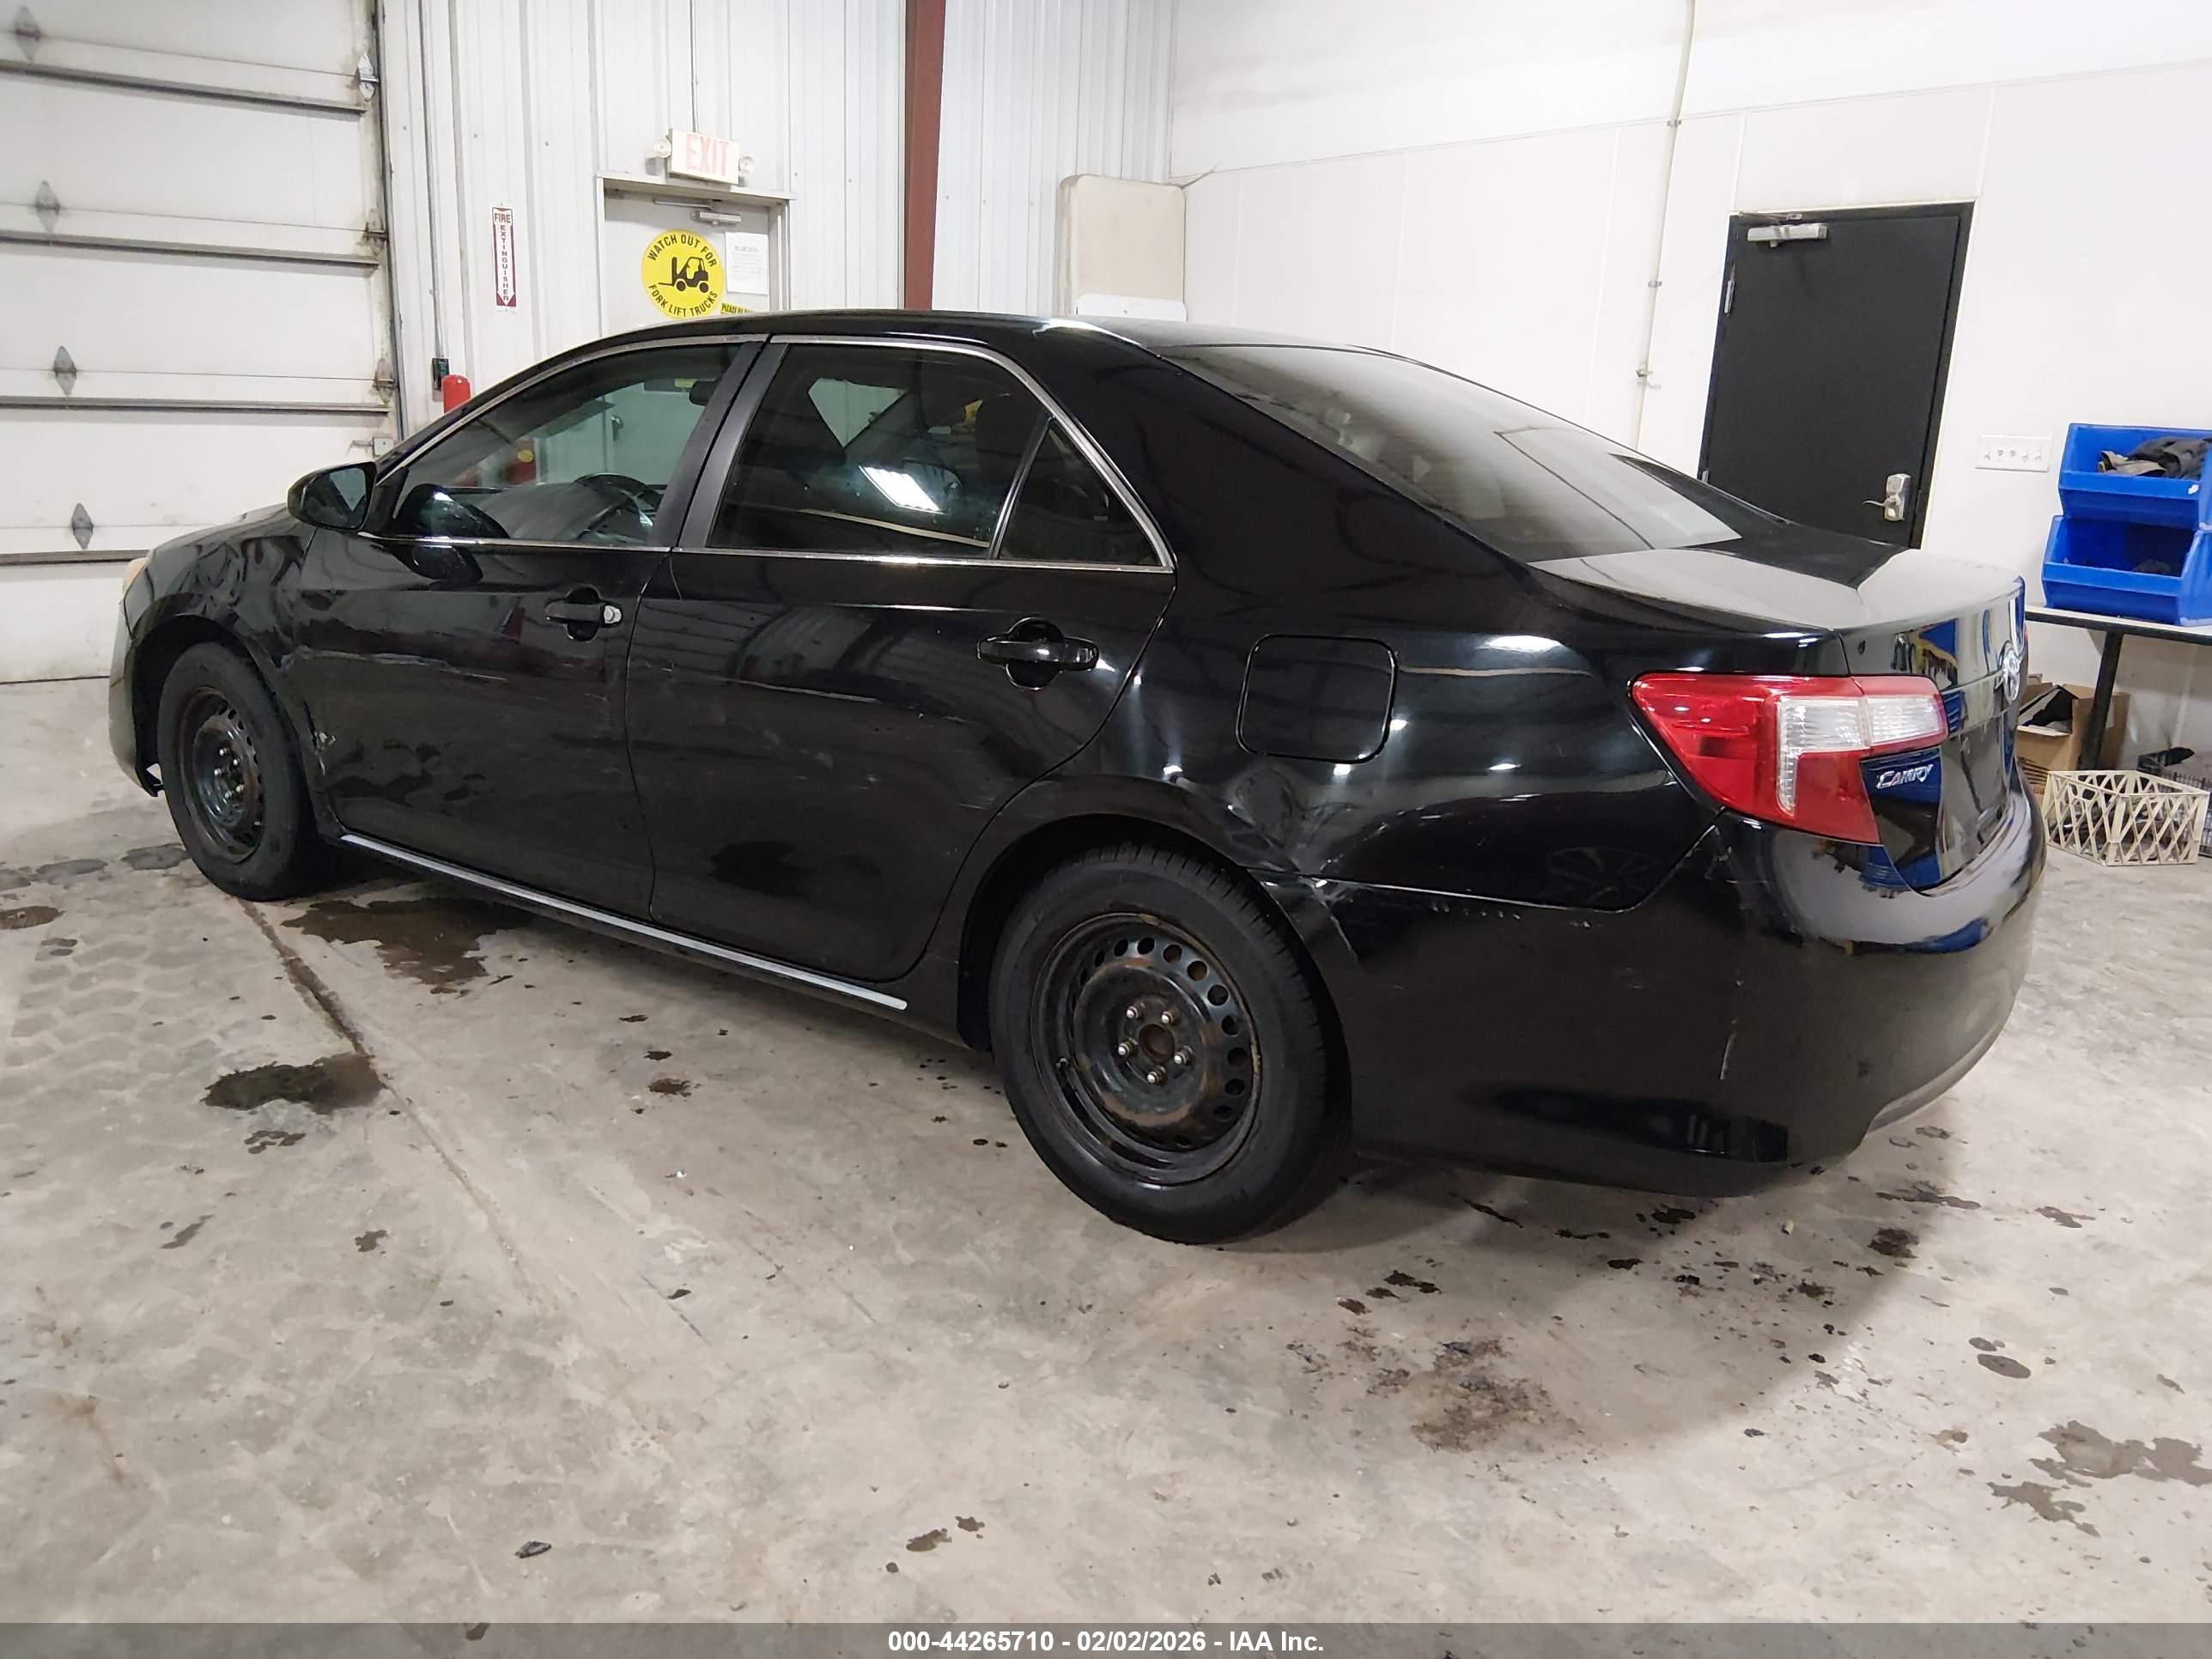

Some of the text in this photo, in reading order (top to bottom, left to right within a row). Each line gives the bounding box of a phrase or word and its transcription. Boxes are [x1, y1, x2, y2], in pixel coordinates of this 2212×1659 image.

[685, 133, 730, 177] EXIT
[494, 212, 512, 224] FIRE
[499, 224, 510, 301] EXTINGUISHER
[647, 234, 678, 261] WATCH
[680, 234, 701, 248] OUT
[700, 246, 717, 267] FOR
[647, 283, 719, 317] FORK LIFT TRUCKS
